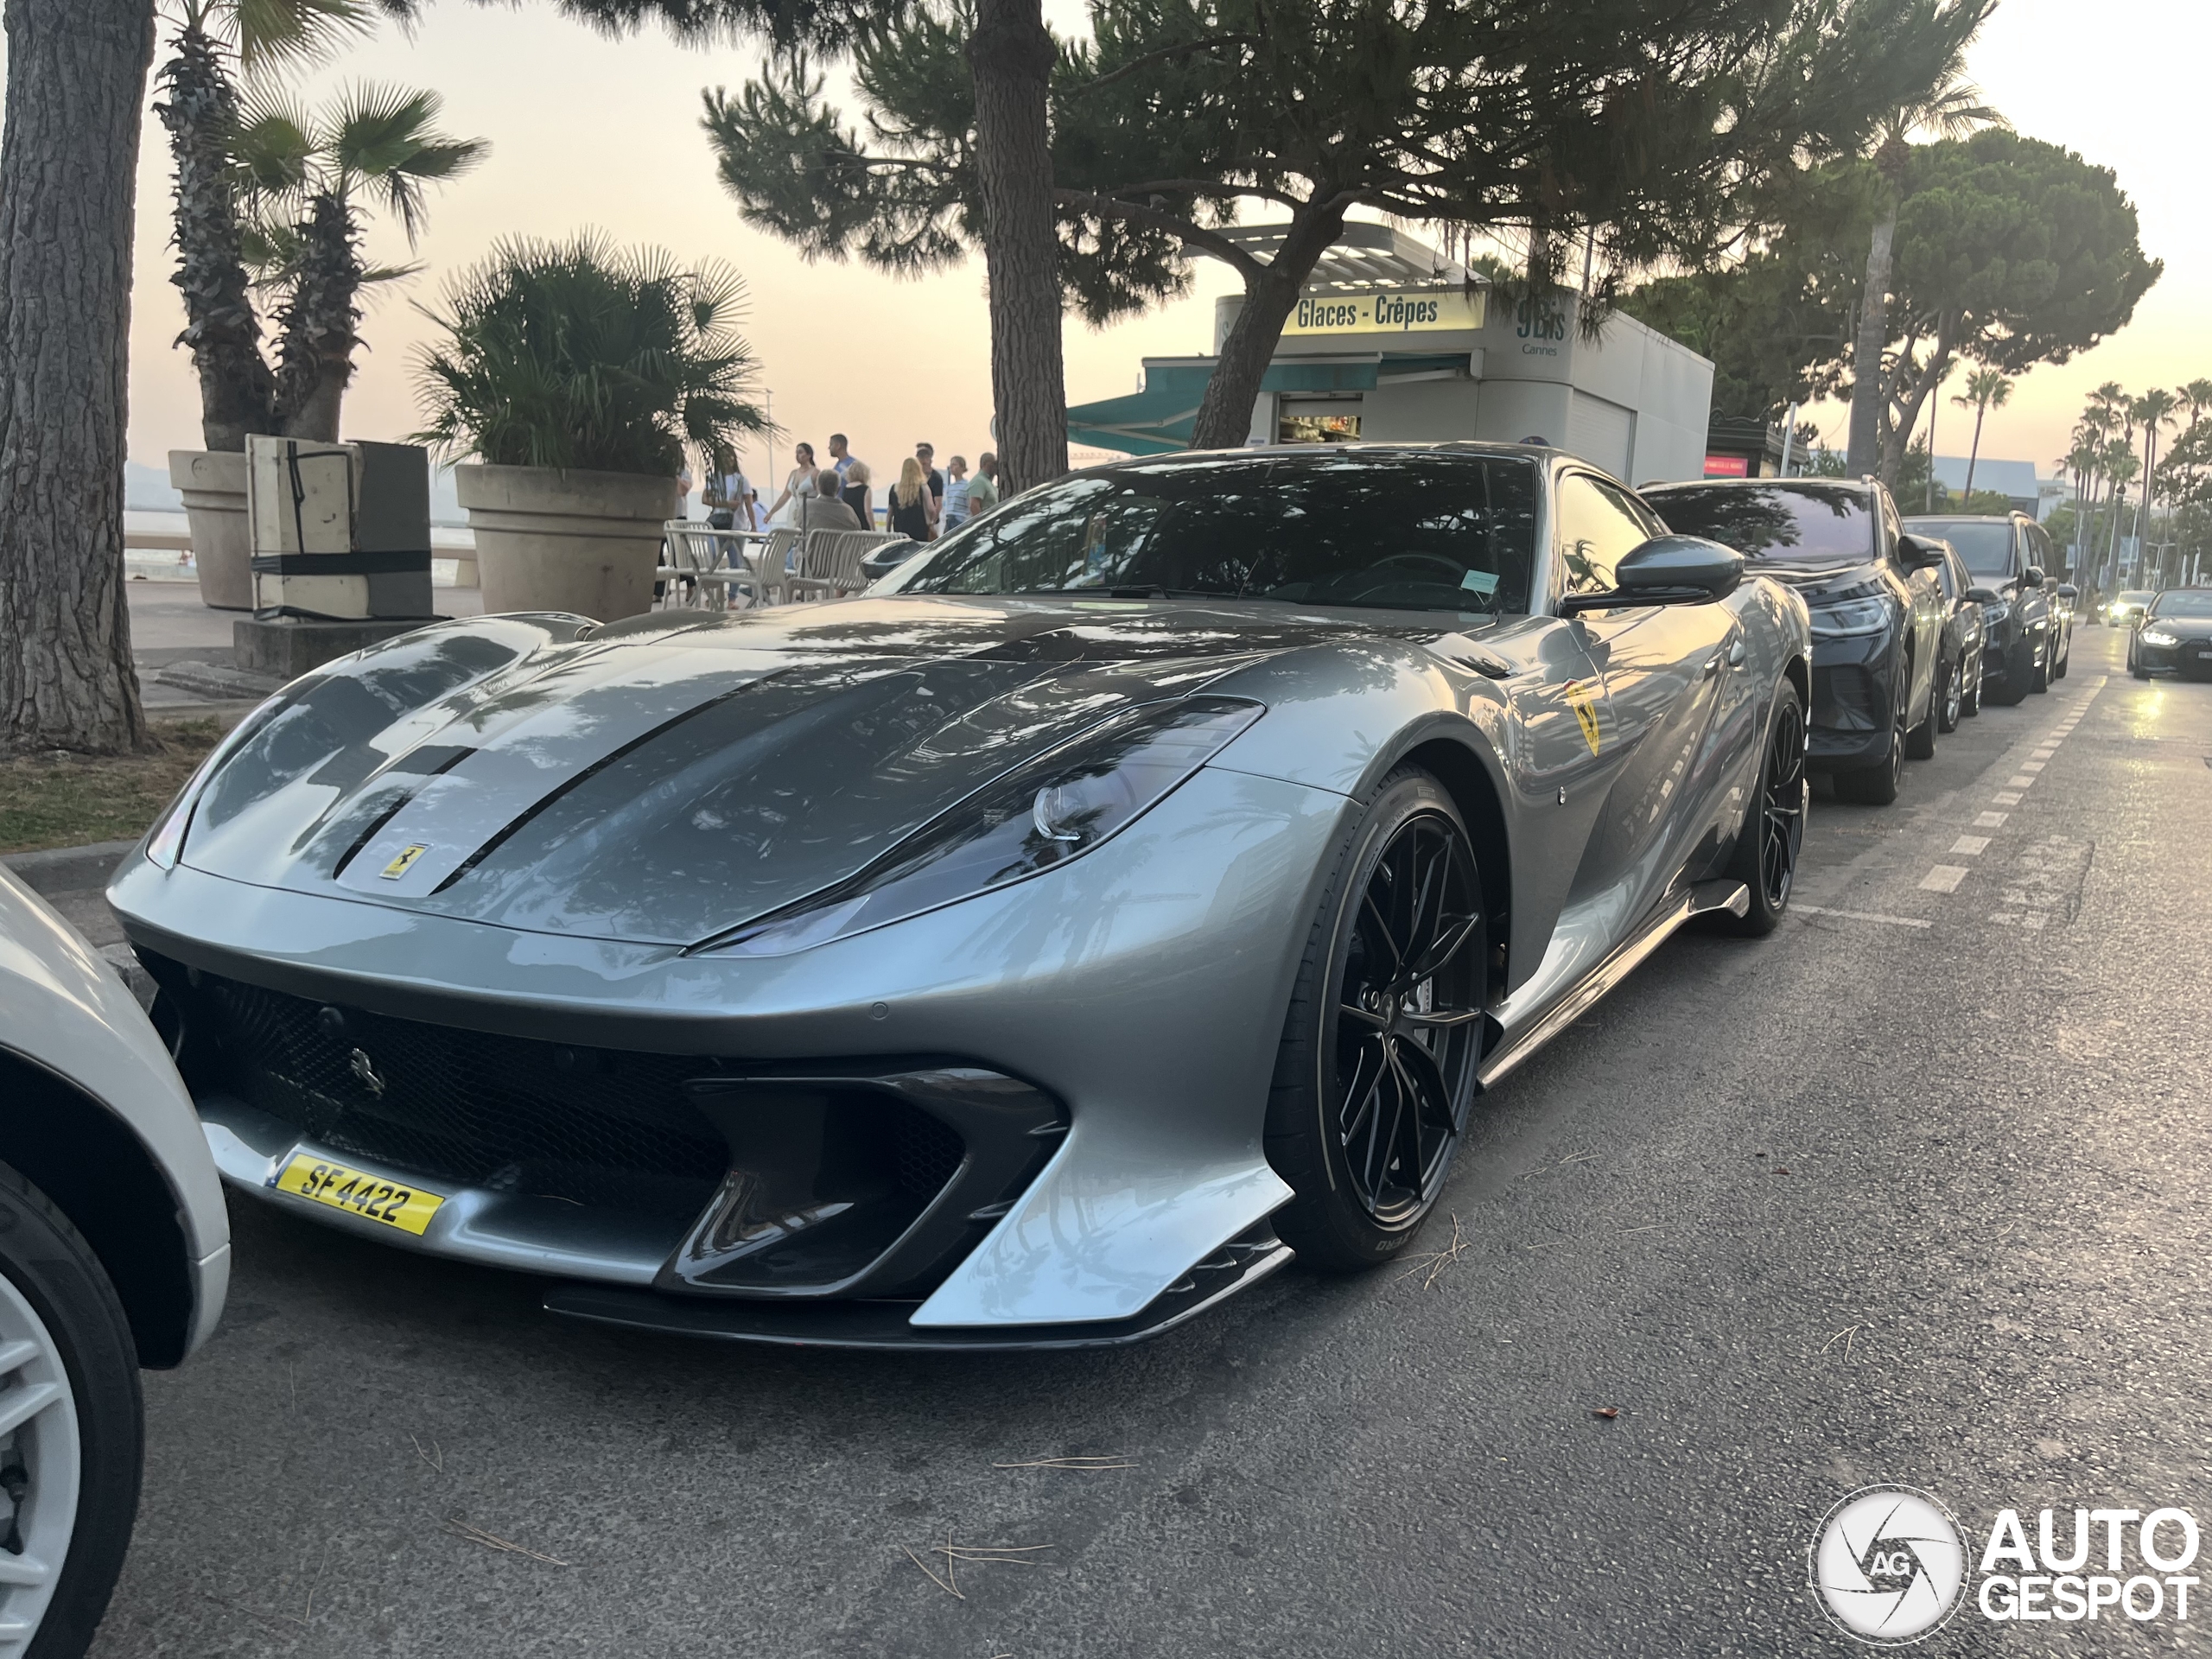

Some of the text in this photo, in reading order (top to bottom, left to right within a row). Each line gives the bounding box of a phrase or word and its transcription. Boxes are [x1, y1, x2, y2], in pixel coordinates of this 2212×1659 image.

[1298, 299, 1357, 327] Glaces
[1376, 295, 1438, 330] Crêpes
[1522, 343, 1557, 356] Cannes
[301, 1165, 411, 1223] SF4422
